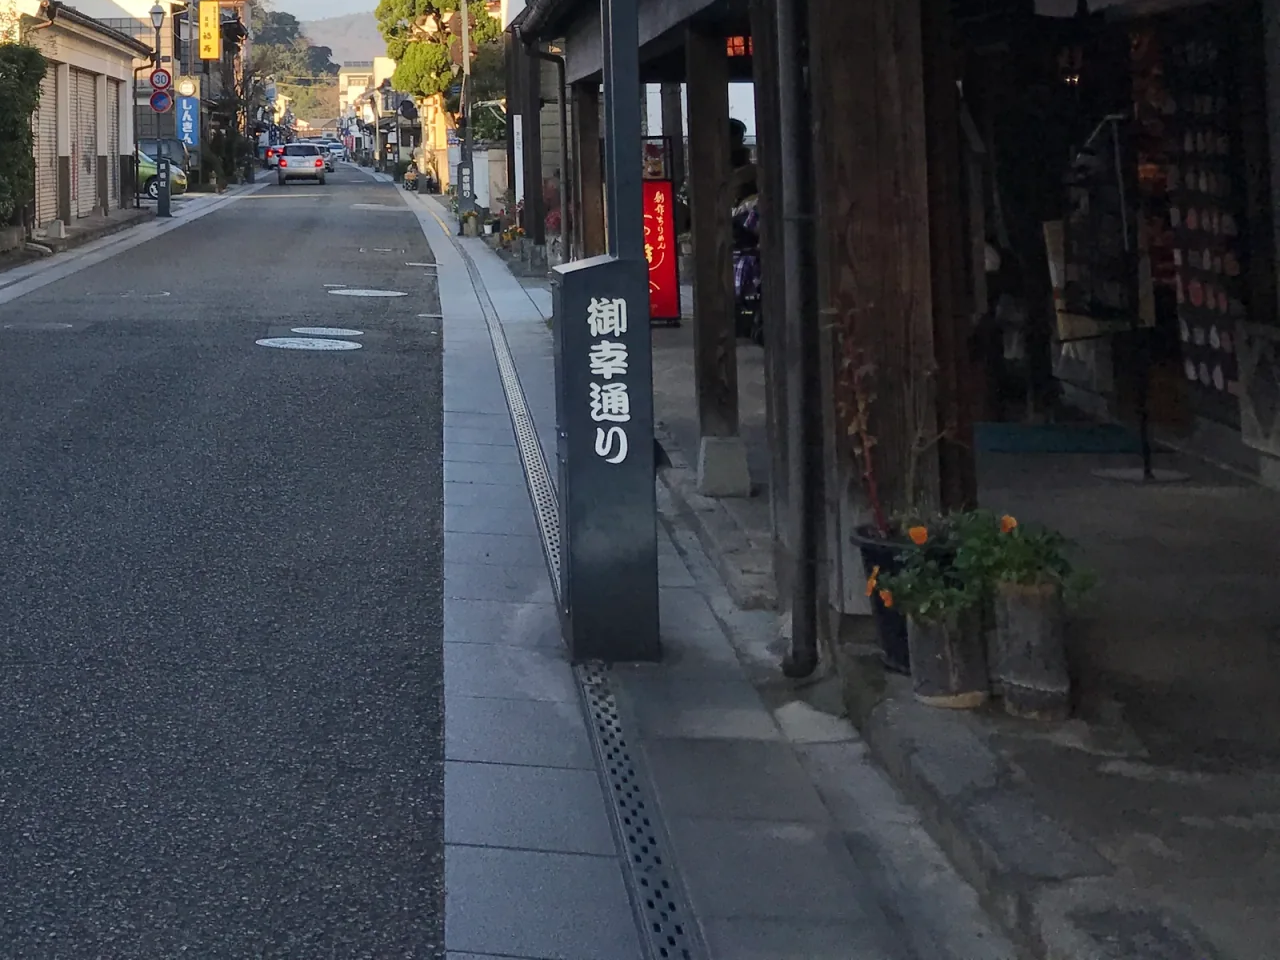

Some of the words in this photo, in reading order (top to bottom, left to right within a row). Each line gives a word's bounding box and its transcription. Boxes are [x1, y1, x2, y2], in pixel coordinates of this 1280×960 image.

[154, 74, 167, 85] 30
[181, 99, 194, 145] しんきん
[653, 190, 666, 250] 創作ちりめん
[586, 297, 631, 464] 御幸通り
